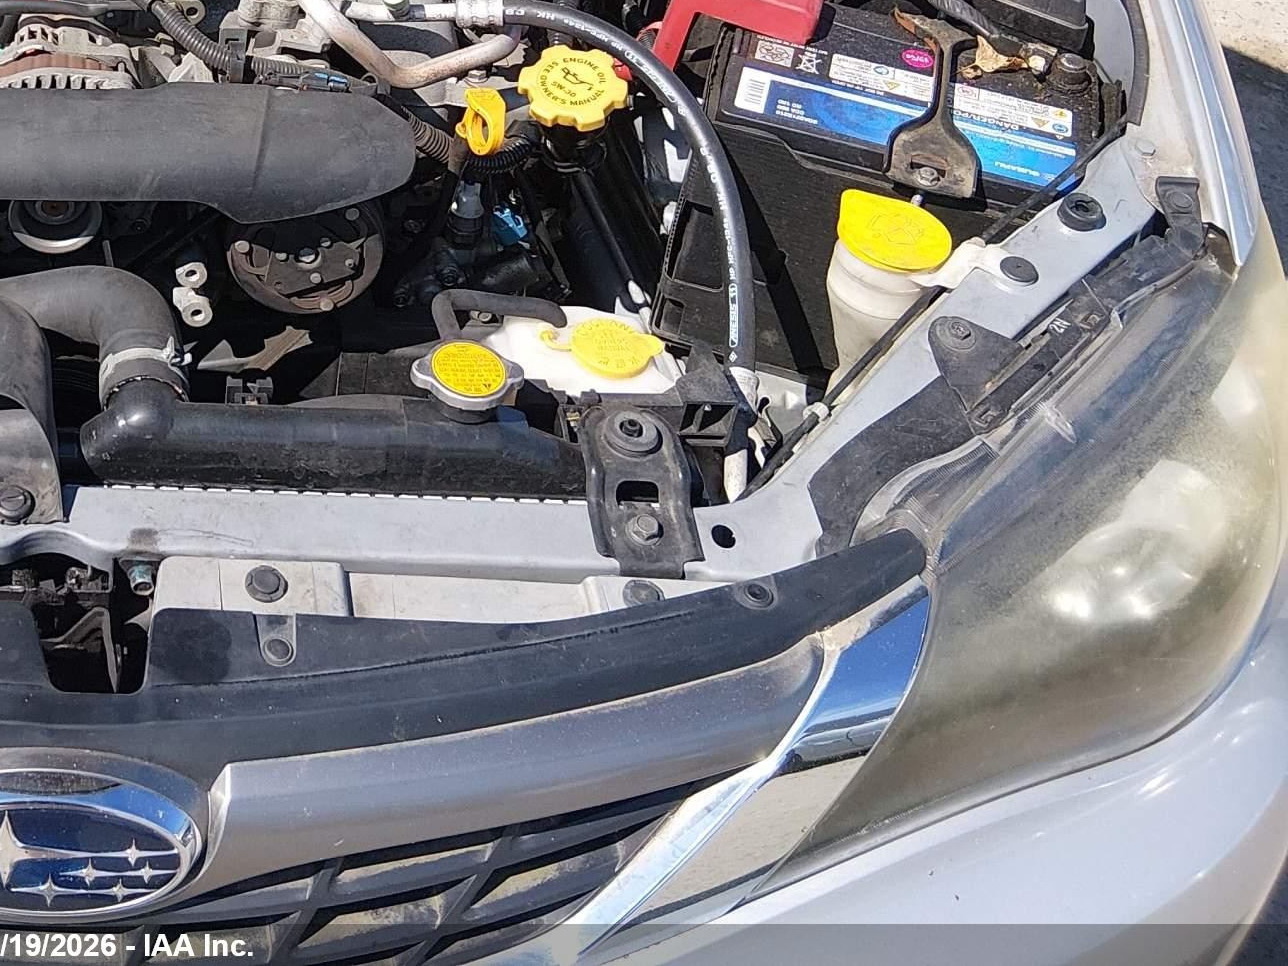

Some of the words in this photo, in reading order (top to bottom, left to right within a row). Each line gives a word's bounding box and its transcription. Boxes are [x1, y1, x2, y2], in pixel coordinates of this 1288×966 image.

[543, 61, 559, 73] SEE
[562, 57, 599, 71] ENGINE
[597, 72, 607, 84] OIL
[540, 75, 567, 105] OWNER'S
[551, 81, 577, 97] 5W-30
[569, 89, 605, 105] MANUAL
[994, 161, 1040, 177] SUBARU
[1049, 317, 1072, 333] 2N
